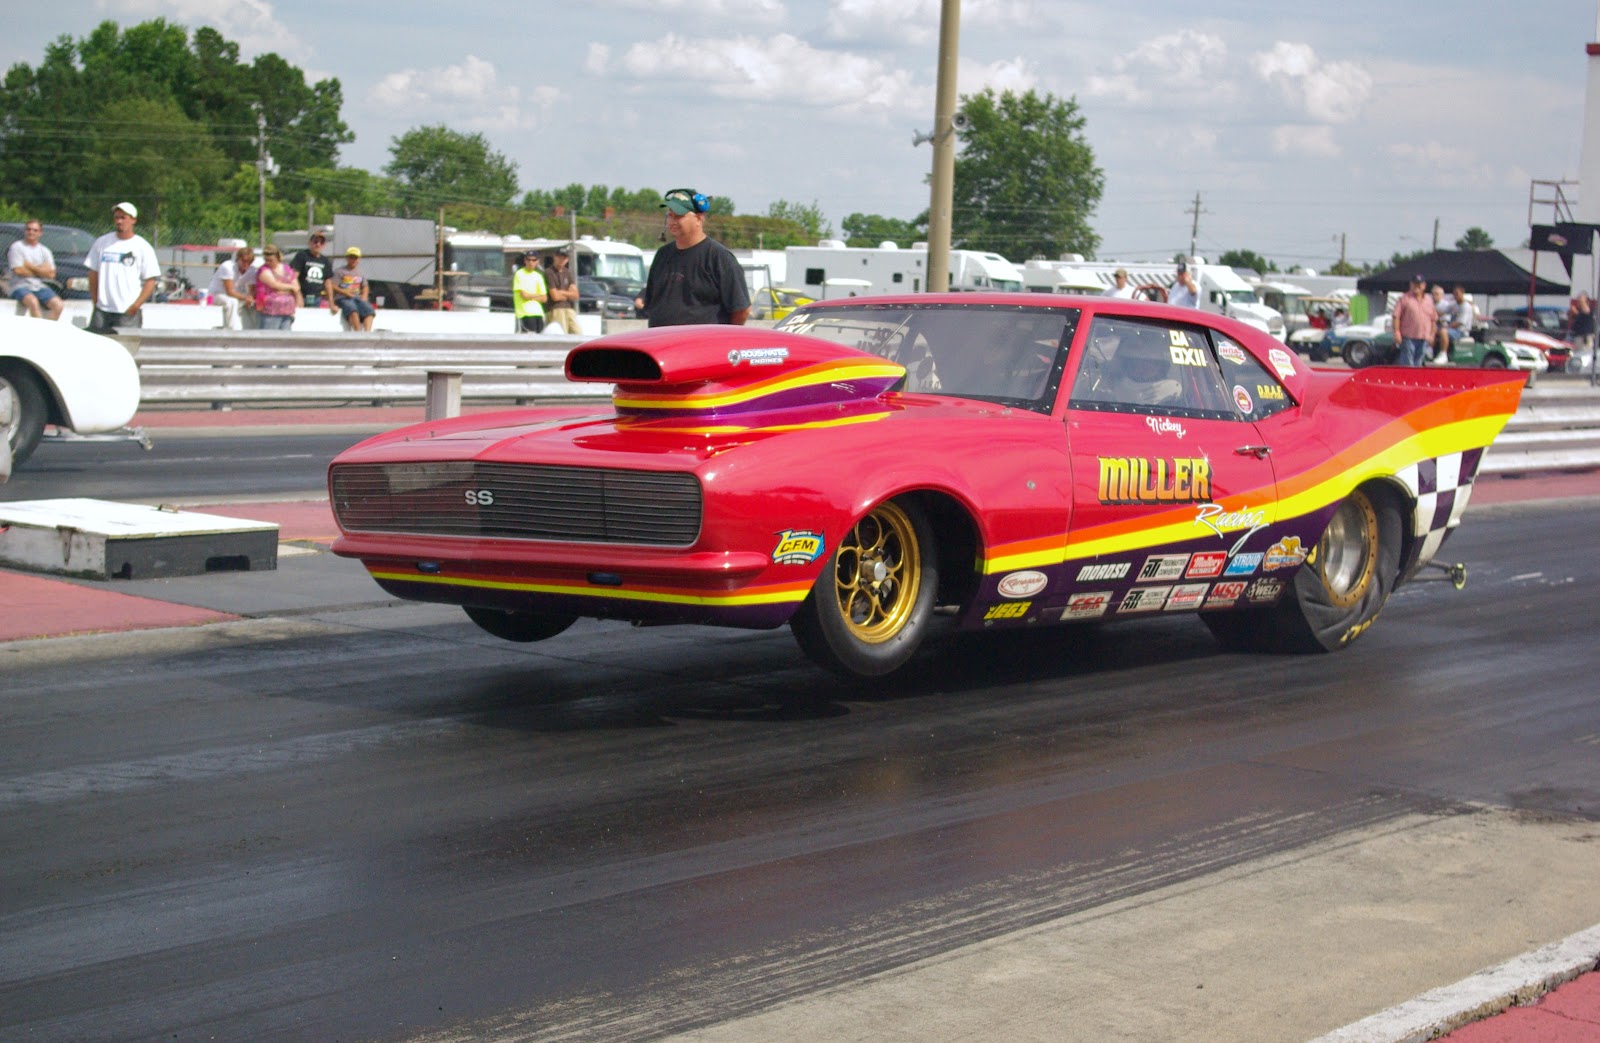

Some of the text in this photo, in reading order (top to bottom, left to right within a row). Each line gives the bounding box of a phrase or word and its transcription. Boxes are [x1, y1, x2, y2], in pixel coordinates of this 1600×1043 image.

[1169, 330, 1190, 347] DA
[1098, 456, 1213, 505] MILLER
[464, 489, 494, 505] SS
[1193, 503, 1269, 556] Racing
[1232, 554, 1261, 567] STROUD
[1076, 562, 1132, 581] MOROSO
[1210, 582, 1244, 599] MSD
[1255, 585, 1281, 596] WELD
[983, 601, 1032, 619] JEGS
